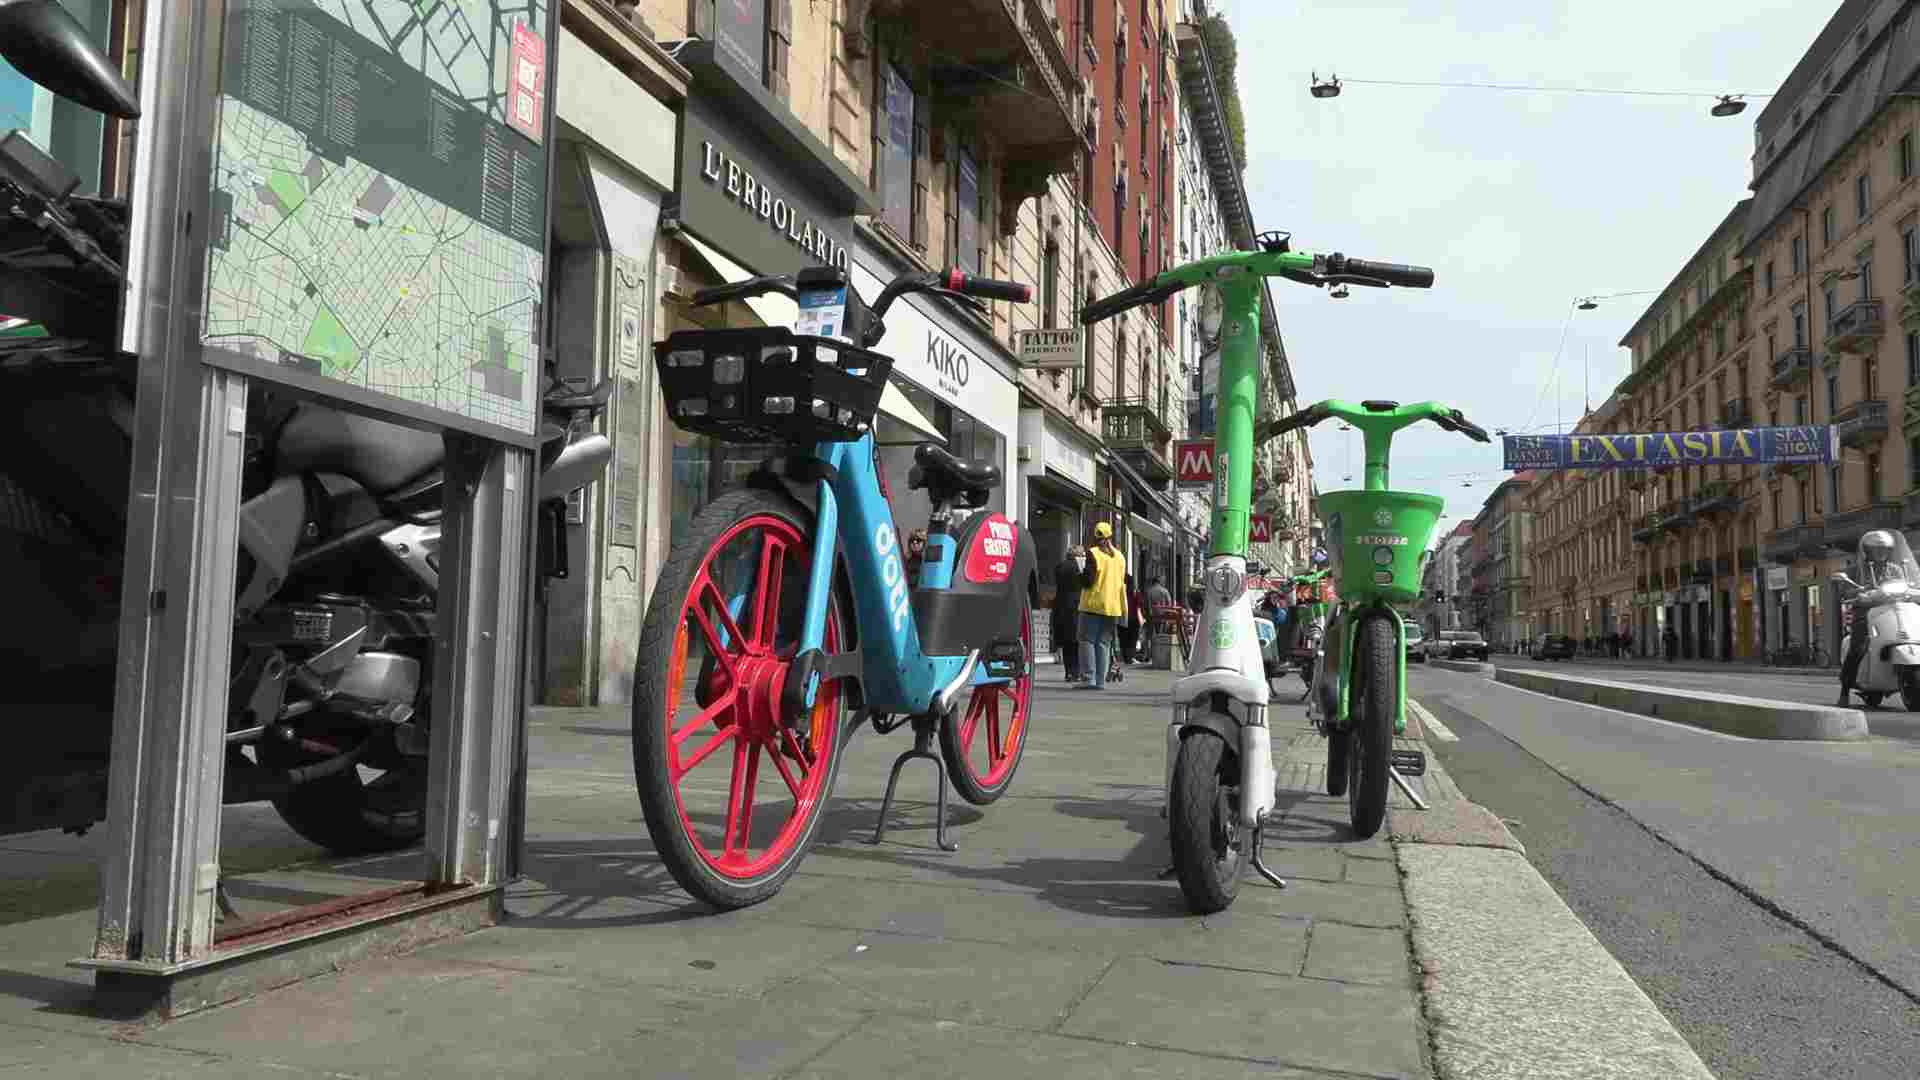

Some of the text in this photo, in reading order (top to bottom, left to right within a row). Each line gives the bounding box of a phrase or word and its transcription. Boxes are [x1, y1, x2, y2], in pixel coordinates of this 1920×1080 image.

[705, 141, 848, 277] L'ERBOLARIO
[1023, 331, 1081, 346] TATTOO
[927, 329, 969, 387] KIKO
[1775, 427, 1824, 441] SEXY
[1507, 448, 1553, 462] DANCE
[1569, 430, 1755, 464] EXTASIA
[1775, 441, 1824, 455] SHOW
[1180, 451, 1213, 474] M
[875, 522, 909, 632] dott
